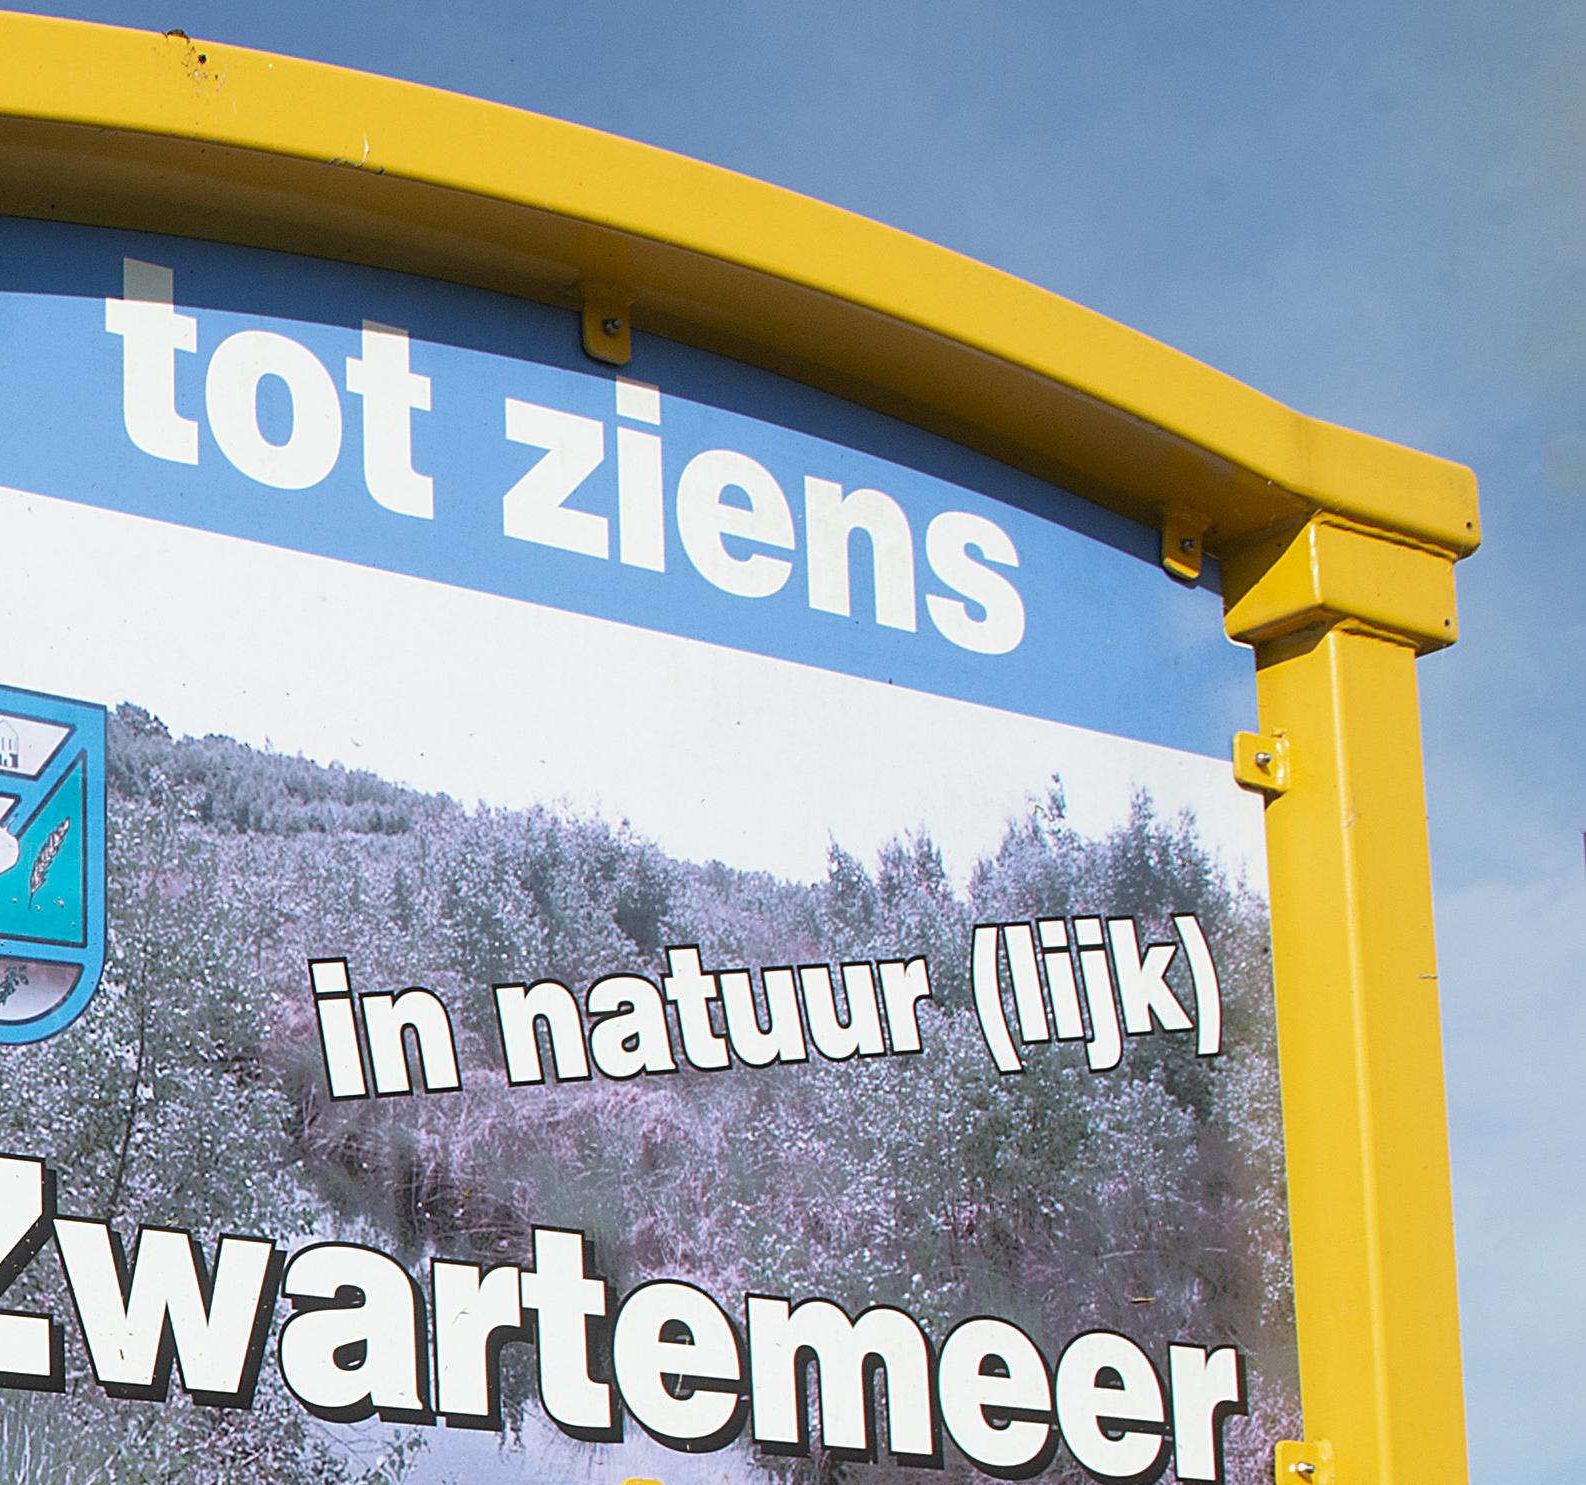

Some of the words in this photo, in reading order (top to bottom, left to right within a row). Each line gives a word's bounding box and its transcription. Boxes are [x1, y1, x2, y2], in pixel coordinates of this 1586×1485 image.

[106, 256, 434, 521] tot
[503, 376, 1029, 656] ziens
[308, 957, 459, 1102] in
[496, 945, 928, 1083] natuur
[970, 913, 1223, 1072] (lijk)
